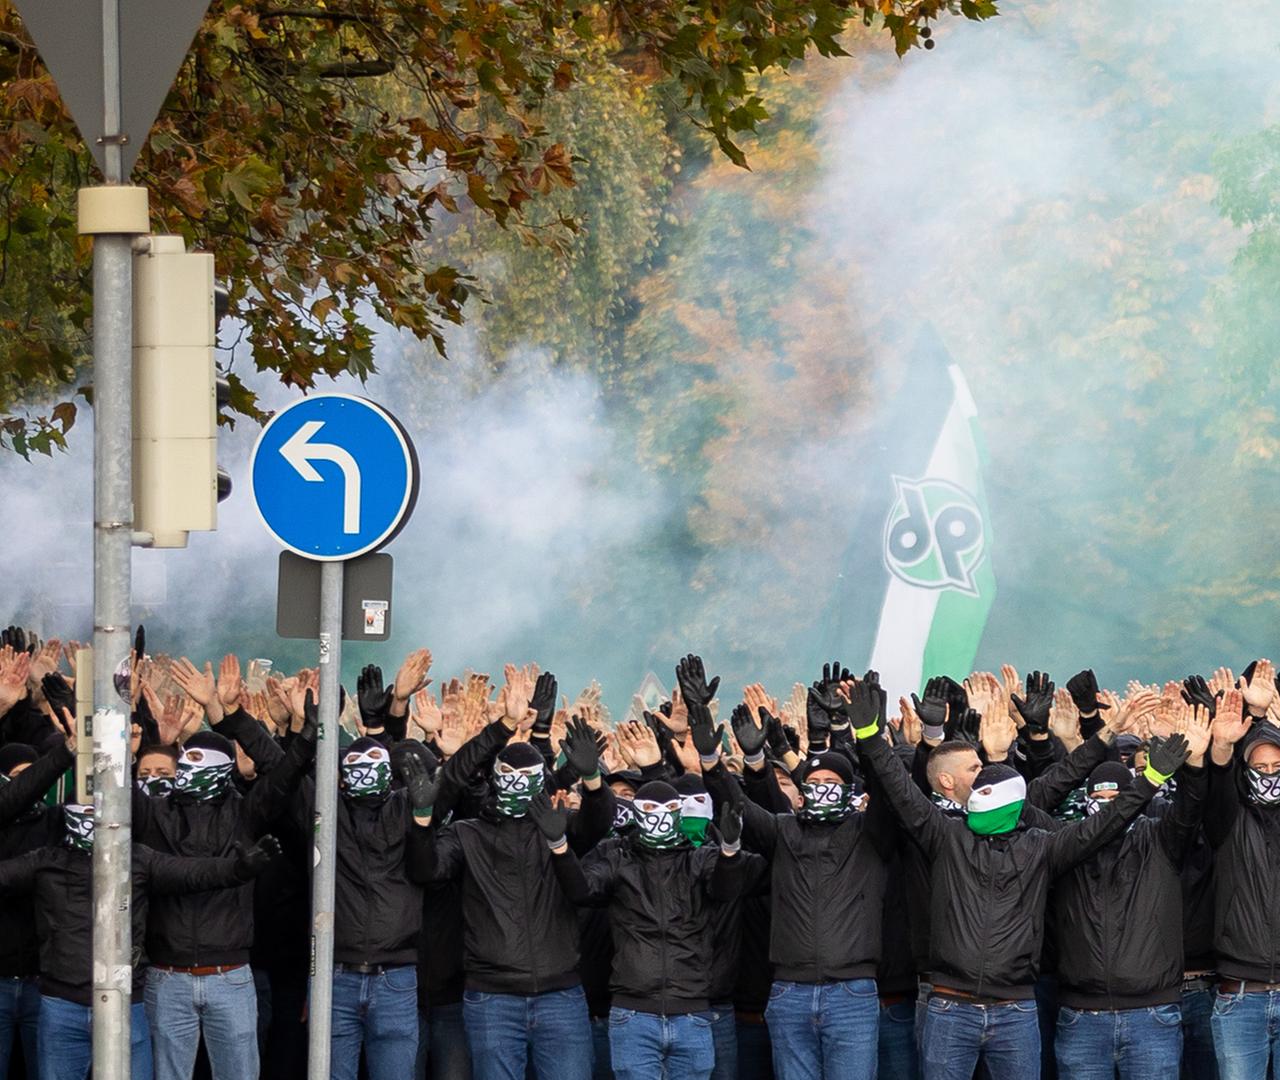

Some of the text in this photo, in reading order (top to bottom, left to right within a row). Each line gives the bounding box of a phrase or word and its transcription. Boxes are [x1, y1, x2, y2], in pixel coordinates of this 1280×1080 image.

[350, 767, 375, 787] 96
[502, 774, 526, 791] 96
[815, 783, 840, 803] 96
[646, 812, 671, 834] 96
